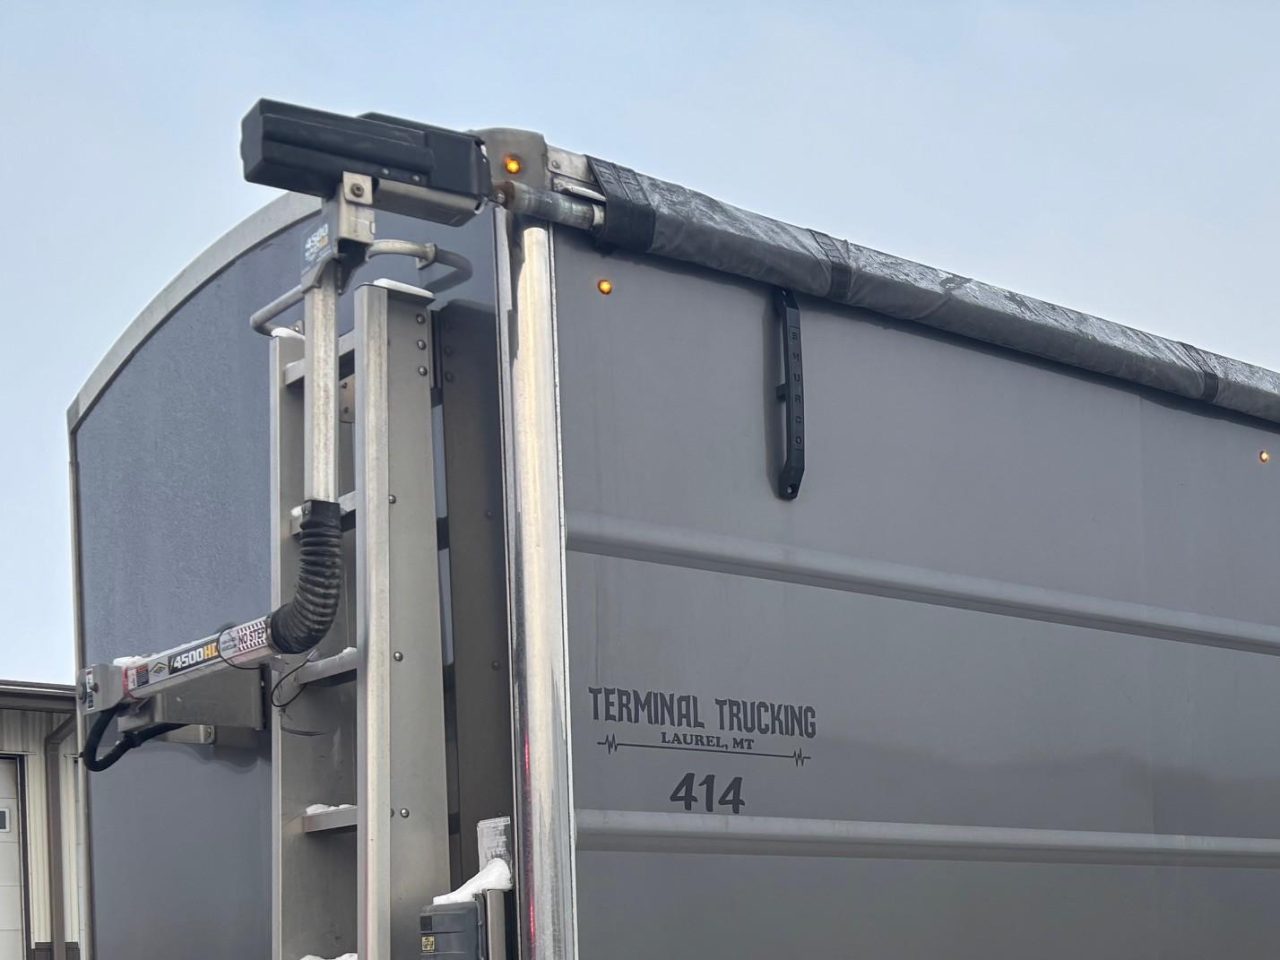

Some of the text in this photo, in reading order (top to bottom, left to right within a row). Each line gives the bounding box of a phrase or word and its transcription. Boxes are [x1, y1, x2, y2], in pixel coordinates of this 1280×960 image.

[238, 632, 248, 646] NO
[249, 626, 265, 643] STEP
[588, 686, 817, 739] TERMINAL TRUCKING
[661, 731, 755, 750] LAUREL, MT
[669, 772, 746, 814] 414
